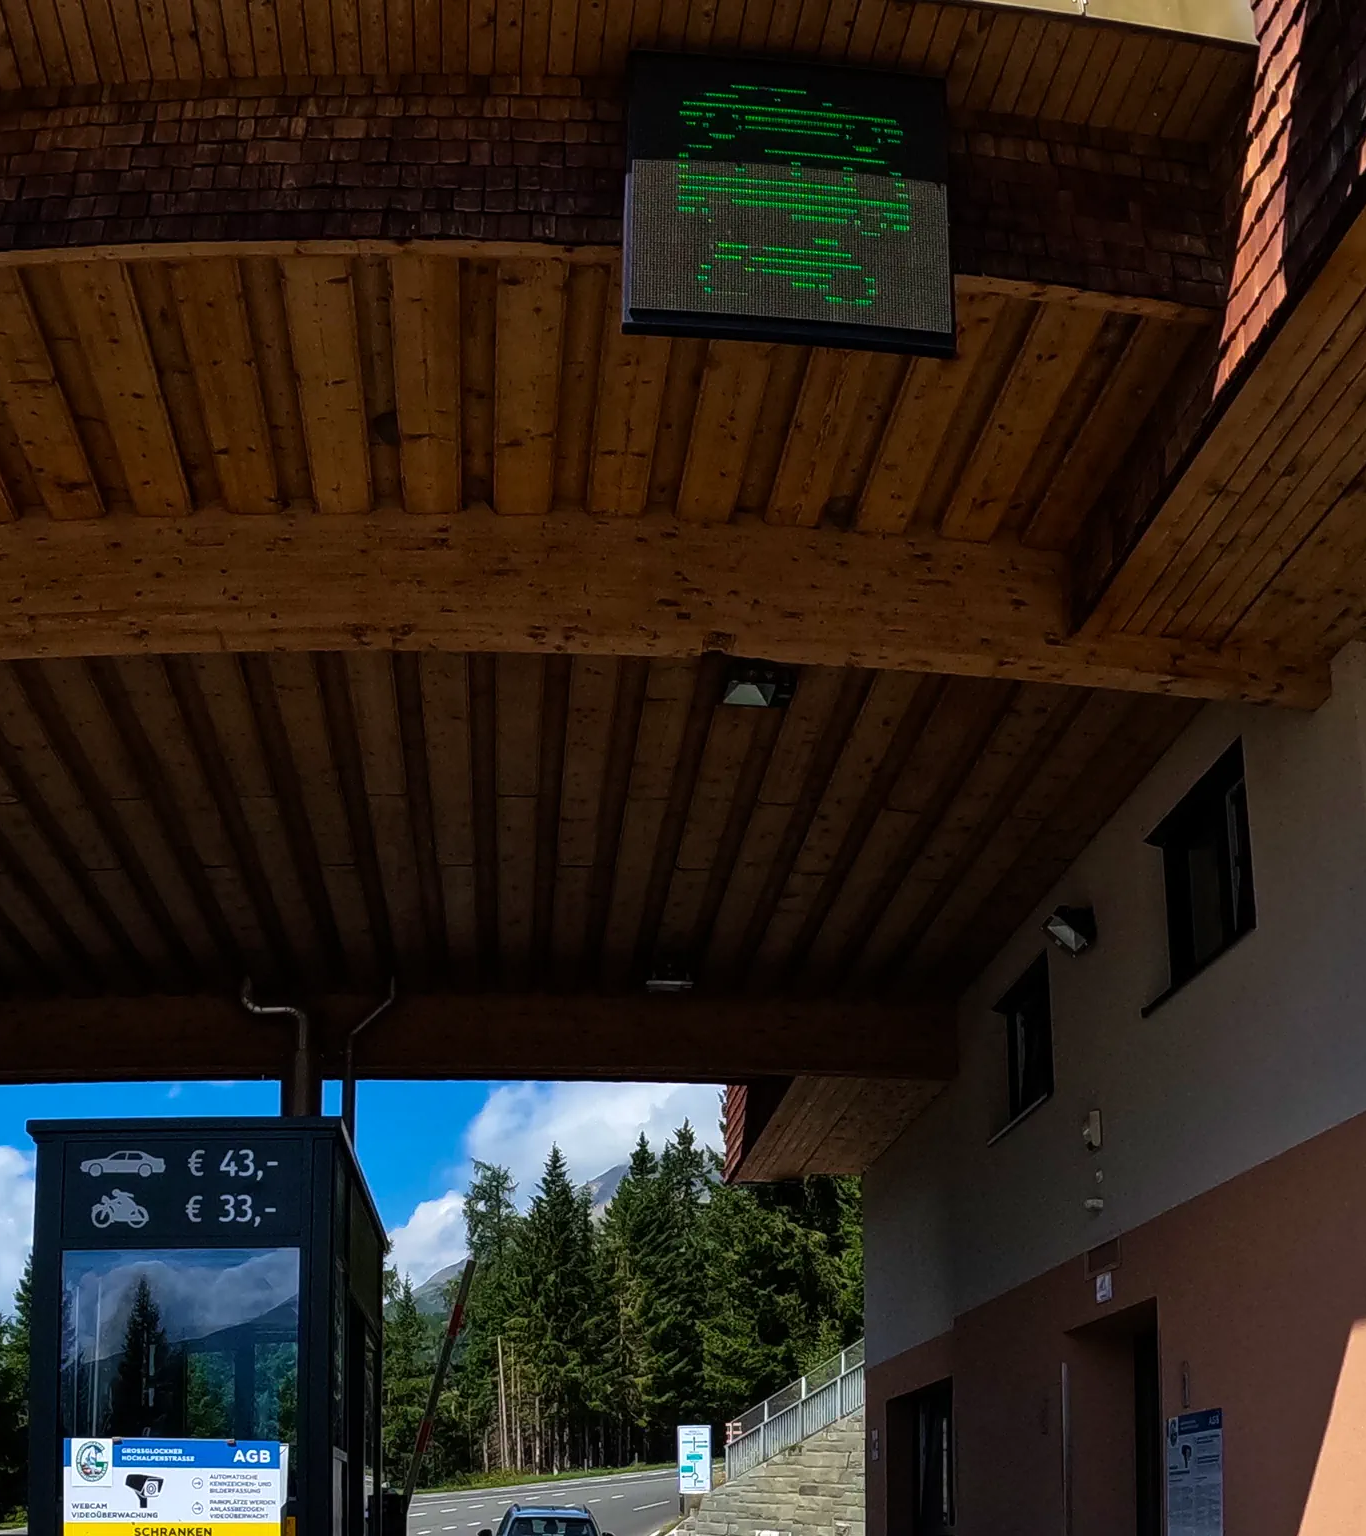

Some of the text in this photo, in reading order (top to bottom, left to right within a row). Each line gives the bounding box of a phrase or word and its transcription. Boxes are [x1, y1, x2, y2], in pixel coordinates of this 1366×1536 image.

[188, 1149, 278, 1181] € 43,-
[186, 1194, 276, 1227] € 33,-
[233, 1450, 271, 1463] AGB
[71, 1511, 158, 1519] VIDEOÜBERWACHUNG
[134, 1528, 212, 1536] SCHRANKEN
